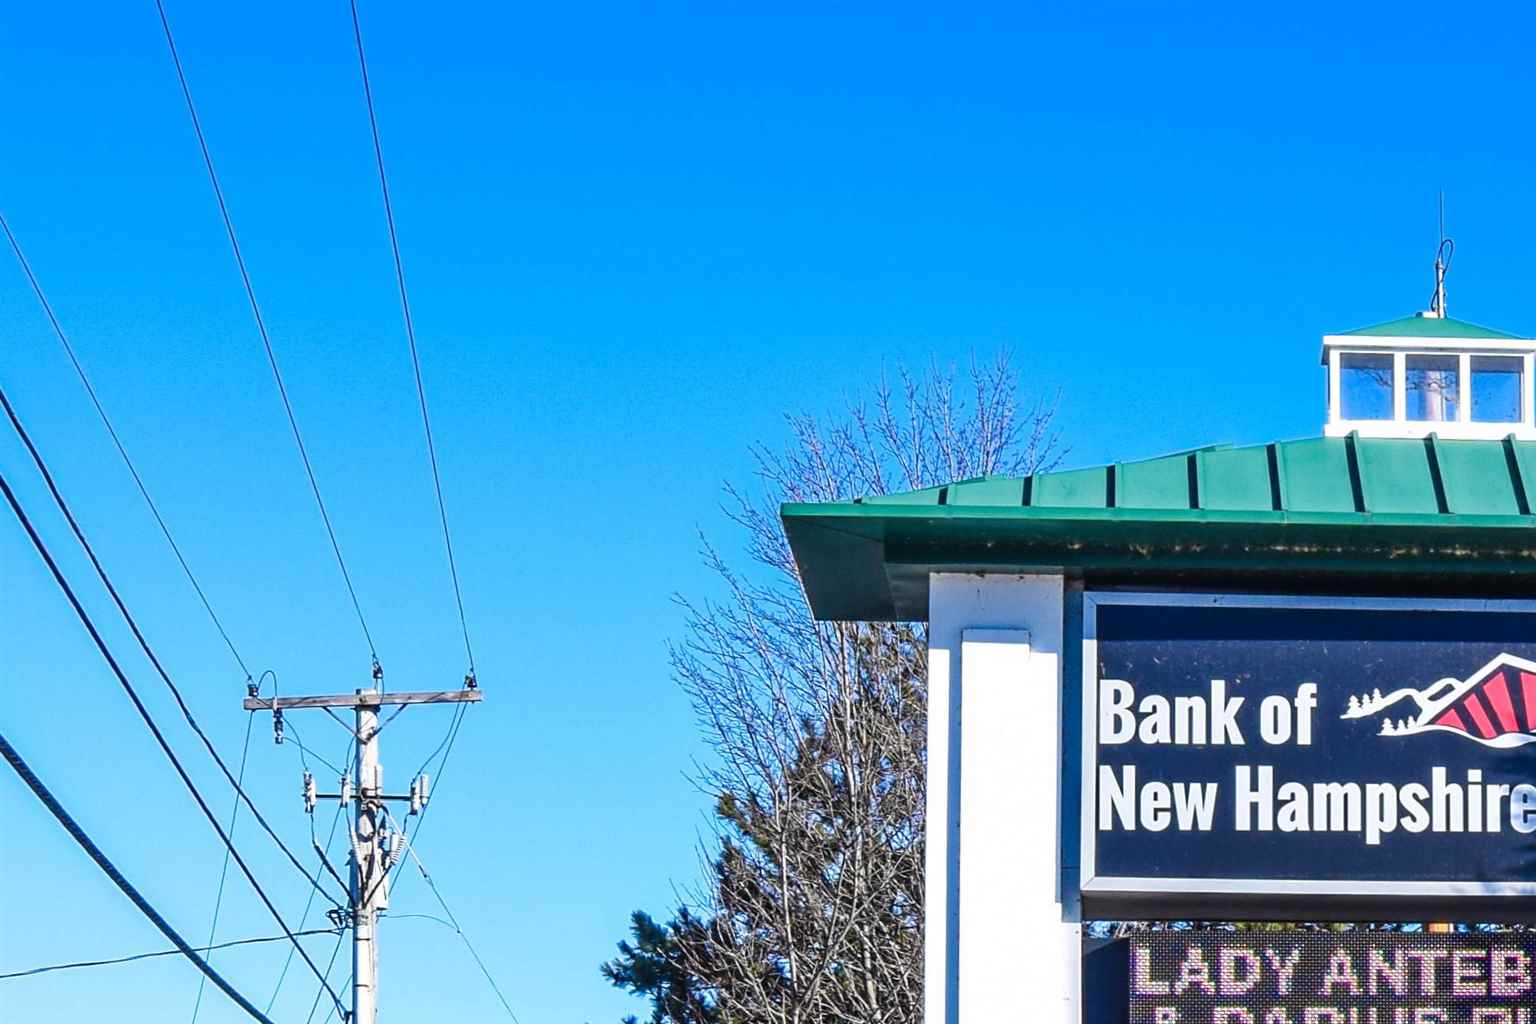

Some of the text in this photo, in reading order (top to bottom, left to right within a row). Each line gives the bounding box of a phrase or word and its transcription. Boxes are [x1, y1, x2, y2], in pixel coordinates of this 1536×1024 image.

[1099, 680, 1318, 746] Bank of
[1099, 765, 1219, 832] New
[1132, 943, 1301, 997] LADY
